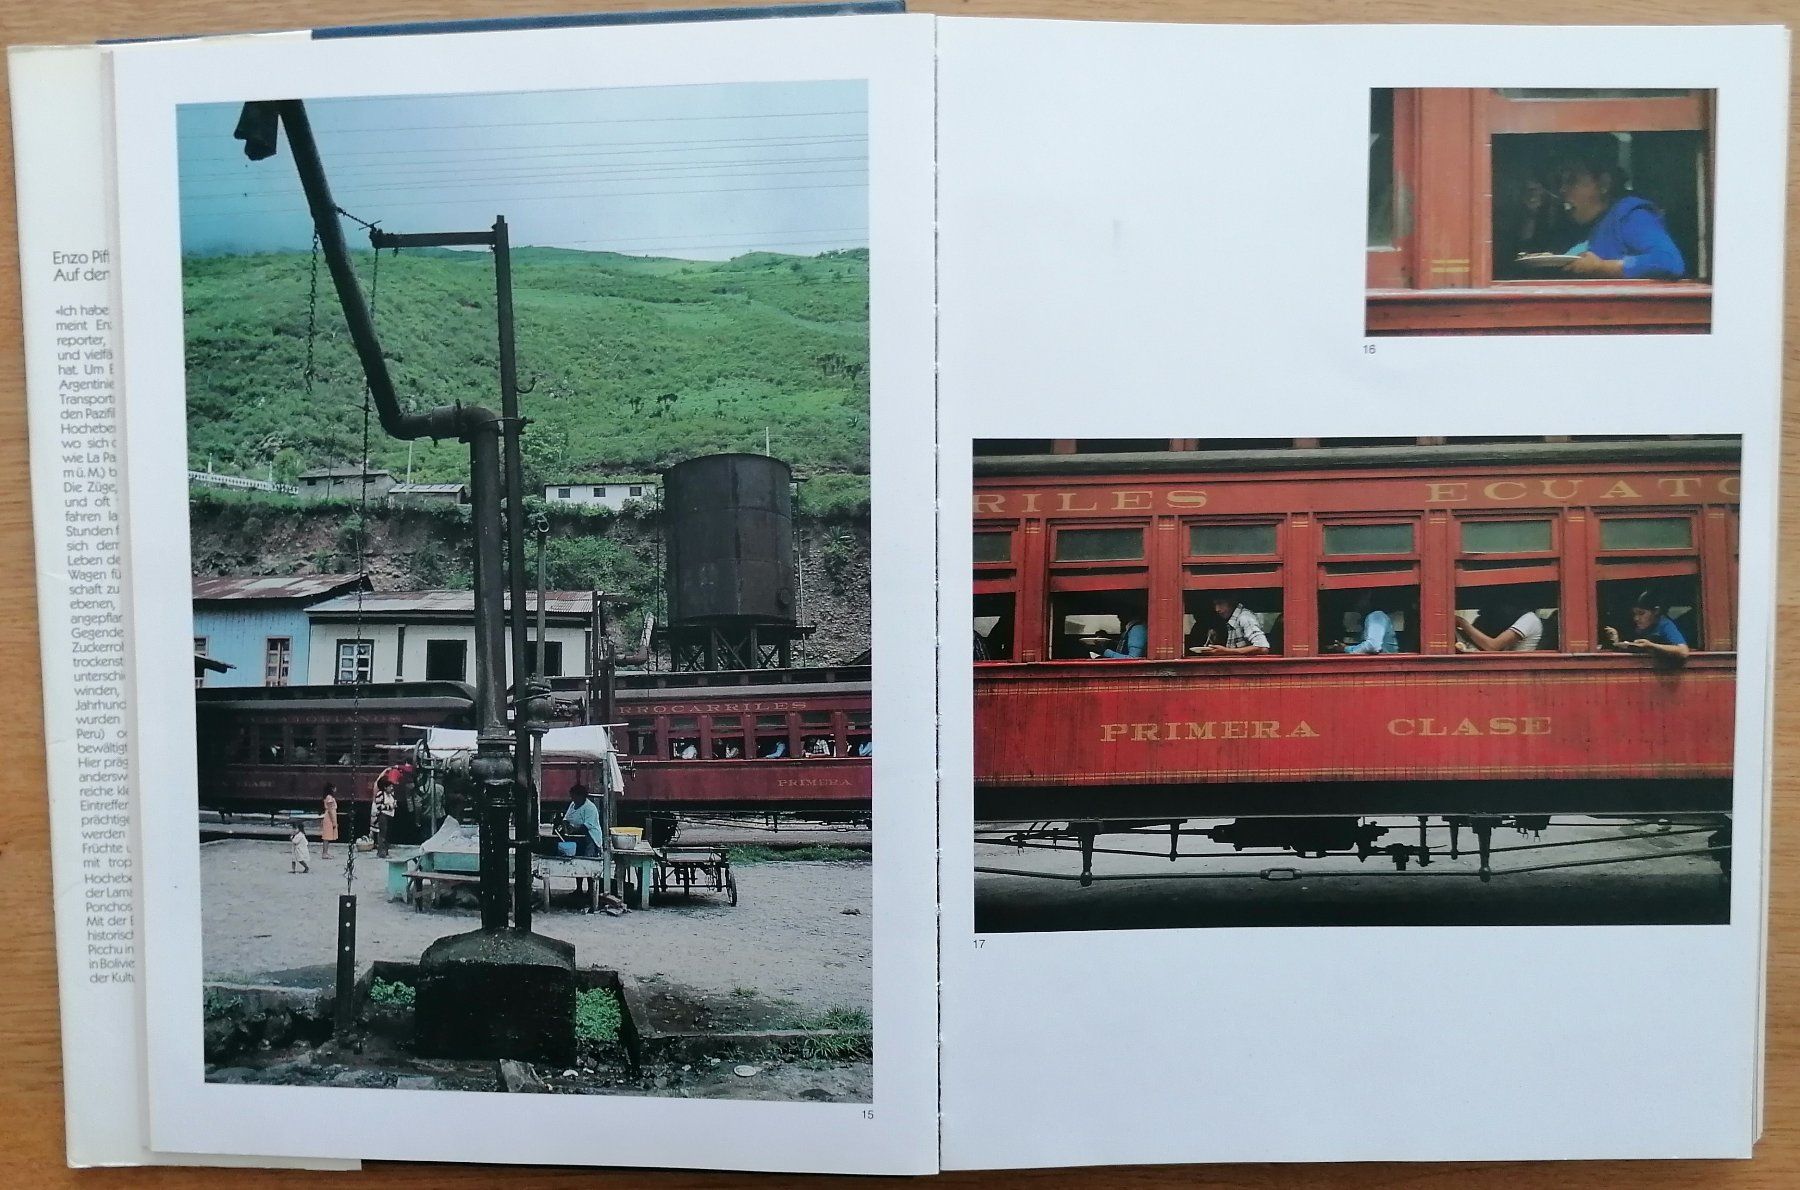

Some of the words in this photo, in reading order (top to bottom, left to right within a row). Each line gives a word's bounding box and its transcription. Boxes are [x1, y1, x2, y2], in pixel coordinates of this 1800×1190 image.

[53, 251, 88, 265] Enzo
[53, 268, 80, 281] Auf
[80, 304, 109, 316] habe
[56, 320, 88, 331] meint
[57, 335, 106, 347] reporter,
[1363, 344, 1376, 354] 16
[58, 350, 80, 360] und
[84, 364, 104, 375] Um
[60, 409, 83, 419] den
[61, 440, 81, 449] wo
[87, 438, 109, 449] sich
[62, 453, 84, 463] wie
[87, 453, 100, 463] La
[63, 481, 82, 493] Die
[64, 497, 87, 507] und
[94, 496, 110, 507] oft
[974, 490, 1207, 513] RILES
[65, 511, 101, 522] fahren
[66, 525, 113, 537] Stunden
[67, 541, 88, 551] sich
[67, 555, 102, 566] Leben
[68, 569, 106, 582] Wagen
[69, 583, 102, 595] schaft
[107, 585, 120, 595] zu
[71, 627, 124, 640] Gegende
[75, 714, 120, 725] wurden
[76, 728, 105, 740] Peru)
[1100, 720, 1320, 742] PRIMERA
[1387, 717, 1552, 736] CLASE
[78, 757, 101, 768] Hier
[80, 786, 113, 797] reiche
[82, 830, 125, 840] werden
[82, 842, 123, 854] Früchte
[83, 858, 100, 868] mit
[85, 888, 104, 898] der
[86, 902, 133, 912] Ponchos
[86, 916, 104, 927] Mit
[107, 915, 126, 926] der
[973, 939, 985, 948] 17
[88, 944, 123, 955] Picchu
[89, 959, 99, 969] in
[89, 973, 109, 983] der
[863, 1110, 874, 1119] 15
